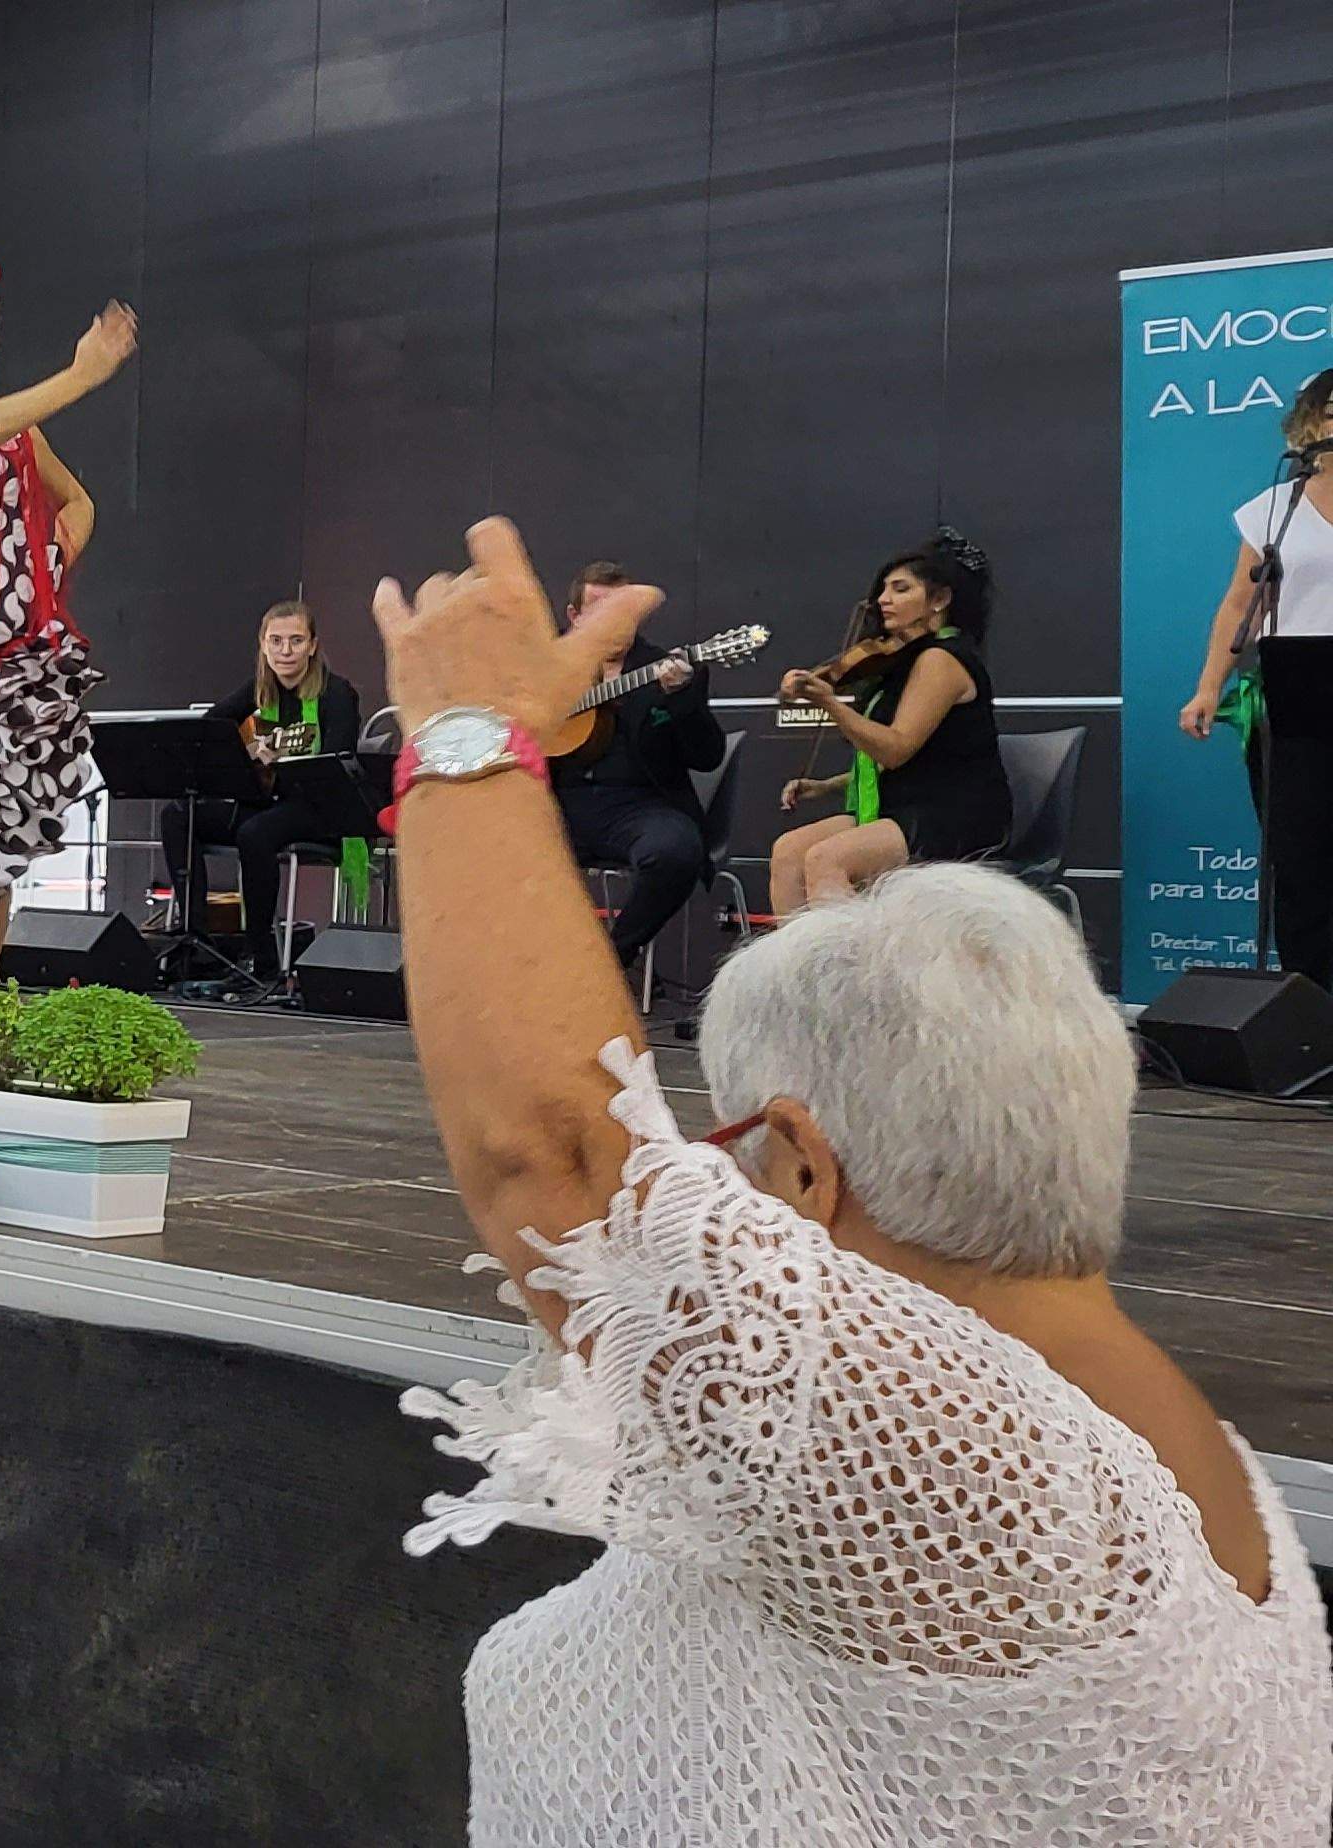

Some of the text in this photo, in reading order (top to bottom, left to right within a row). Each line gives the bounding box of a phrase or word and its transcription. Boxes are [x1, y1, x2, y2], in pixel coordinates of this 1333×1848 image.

[1149, 382, 1195, 418] A
[1207, 375, 1284, 415] LA
[1188, 846, 1258, 871] Todo
[1150, 877, 1259, 901] para tod
